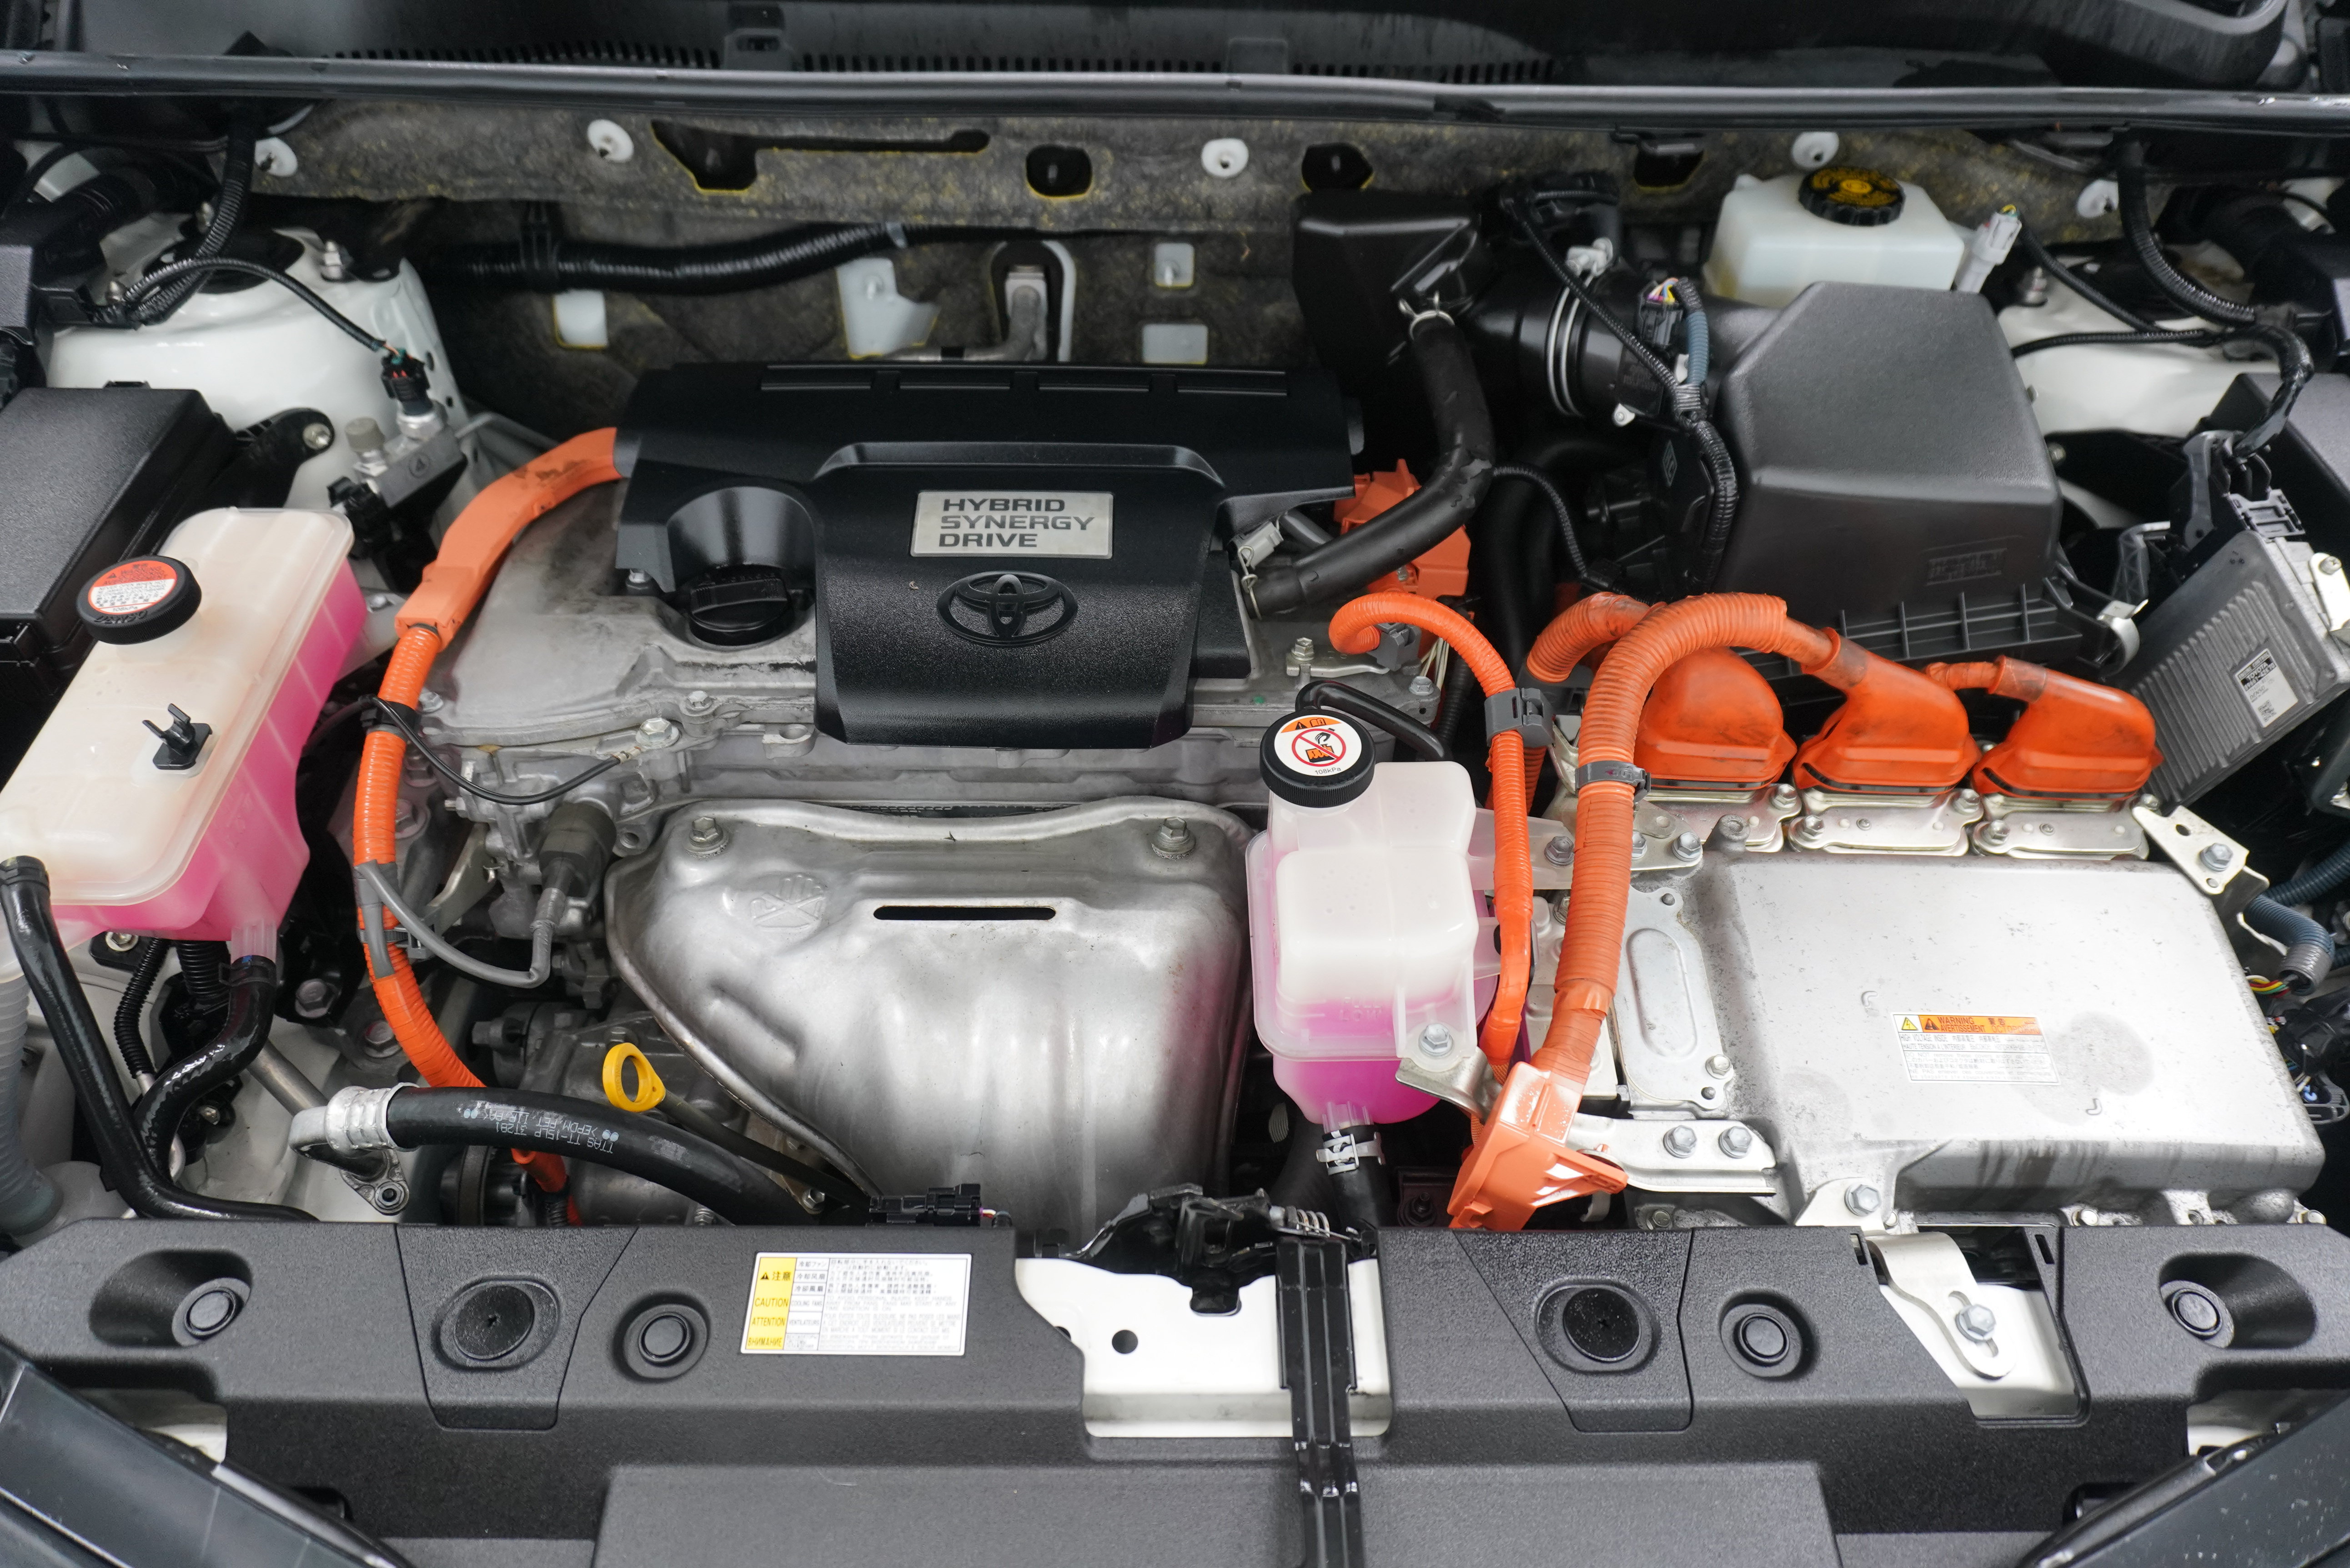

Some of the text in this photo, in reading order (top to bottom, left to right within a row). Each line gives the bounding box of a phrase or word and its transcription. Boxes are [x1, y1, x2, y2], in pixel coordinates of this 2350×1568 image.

[943, 498, 1065, 512] HYBRID
[940, 515, 1096, 530] SYNERGY
[939, 533, 1038, 548] DRIVE
[2246, 662, 2268, 680] TOYOTA
[2250, 686, 2265, 699] DENSO
[1339, 1010, 1382, 1021] LOW
[1938, 1016, 1974, 1025] WARNING
[772, 1271, 791, 1281] 注意
[754, 1298, 788, 1307] CAUTION
[752, 1317, 785, 1327] ATTENTION
[748, 1337, 783, 1347] ВНИМАНИЕ
